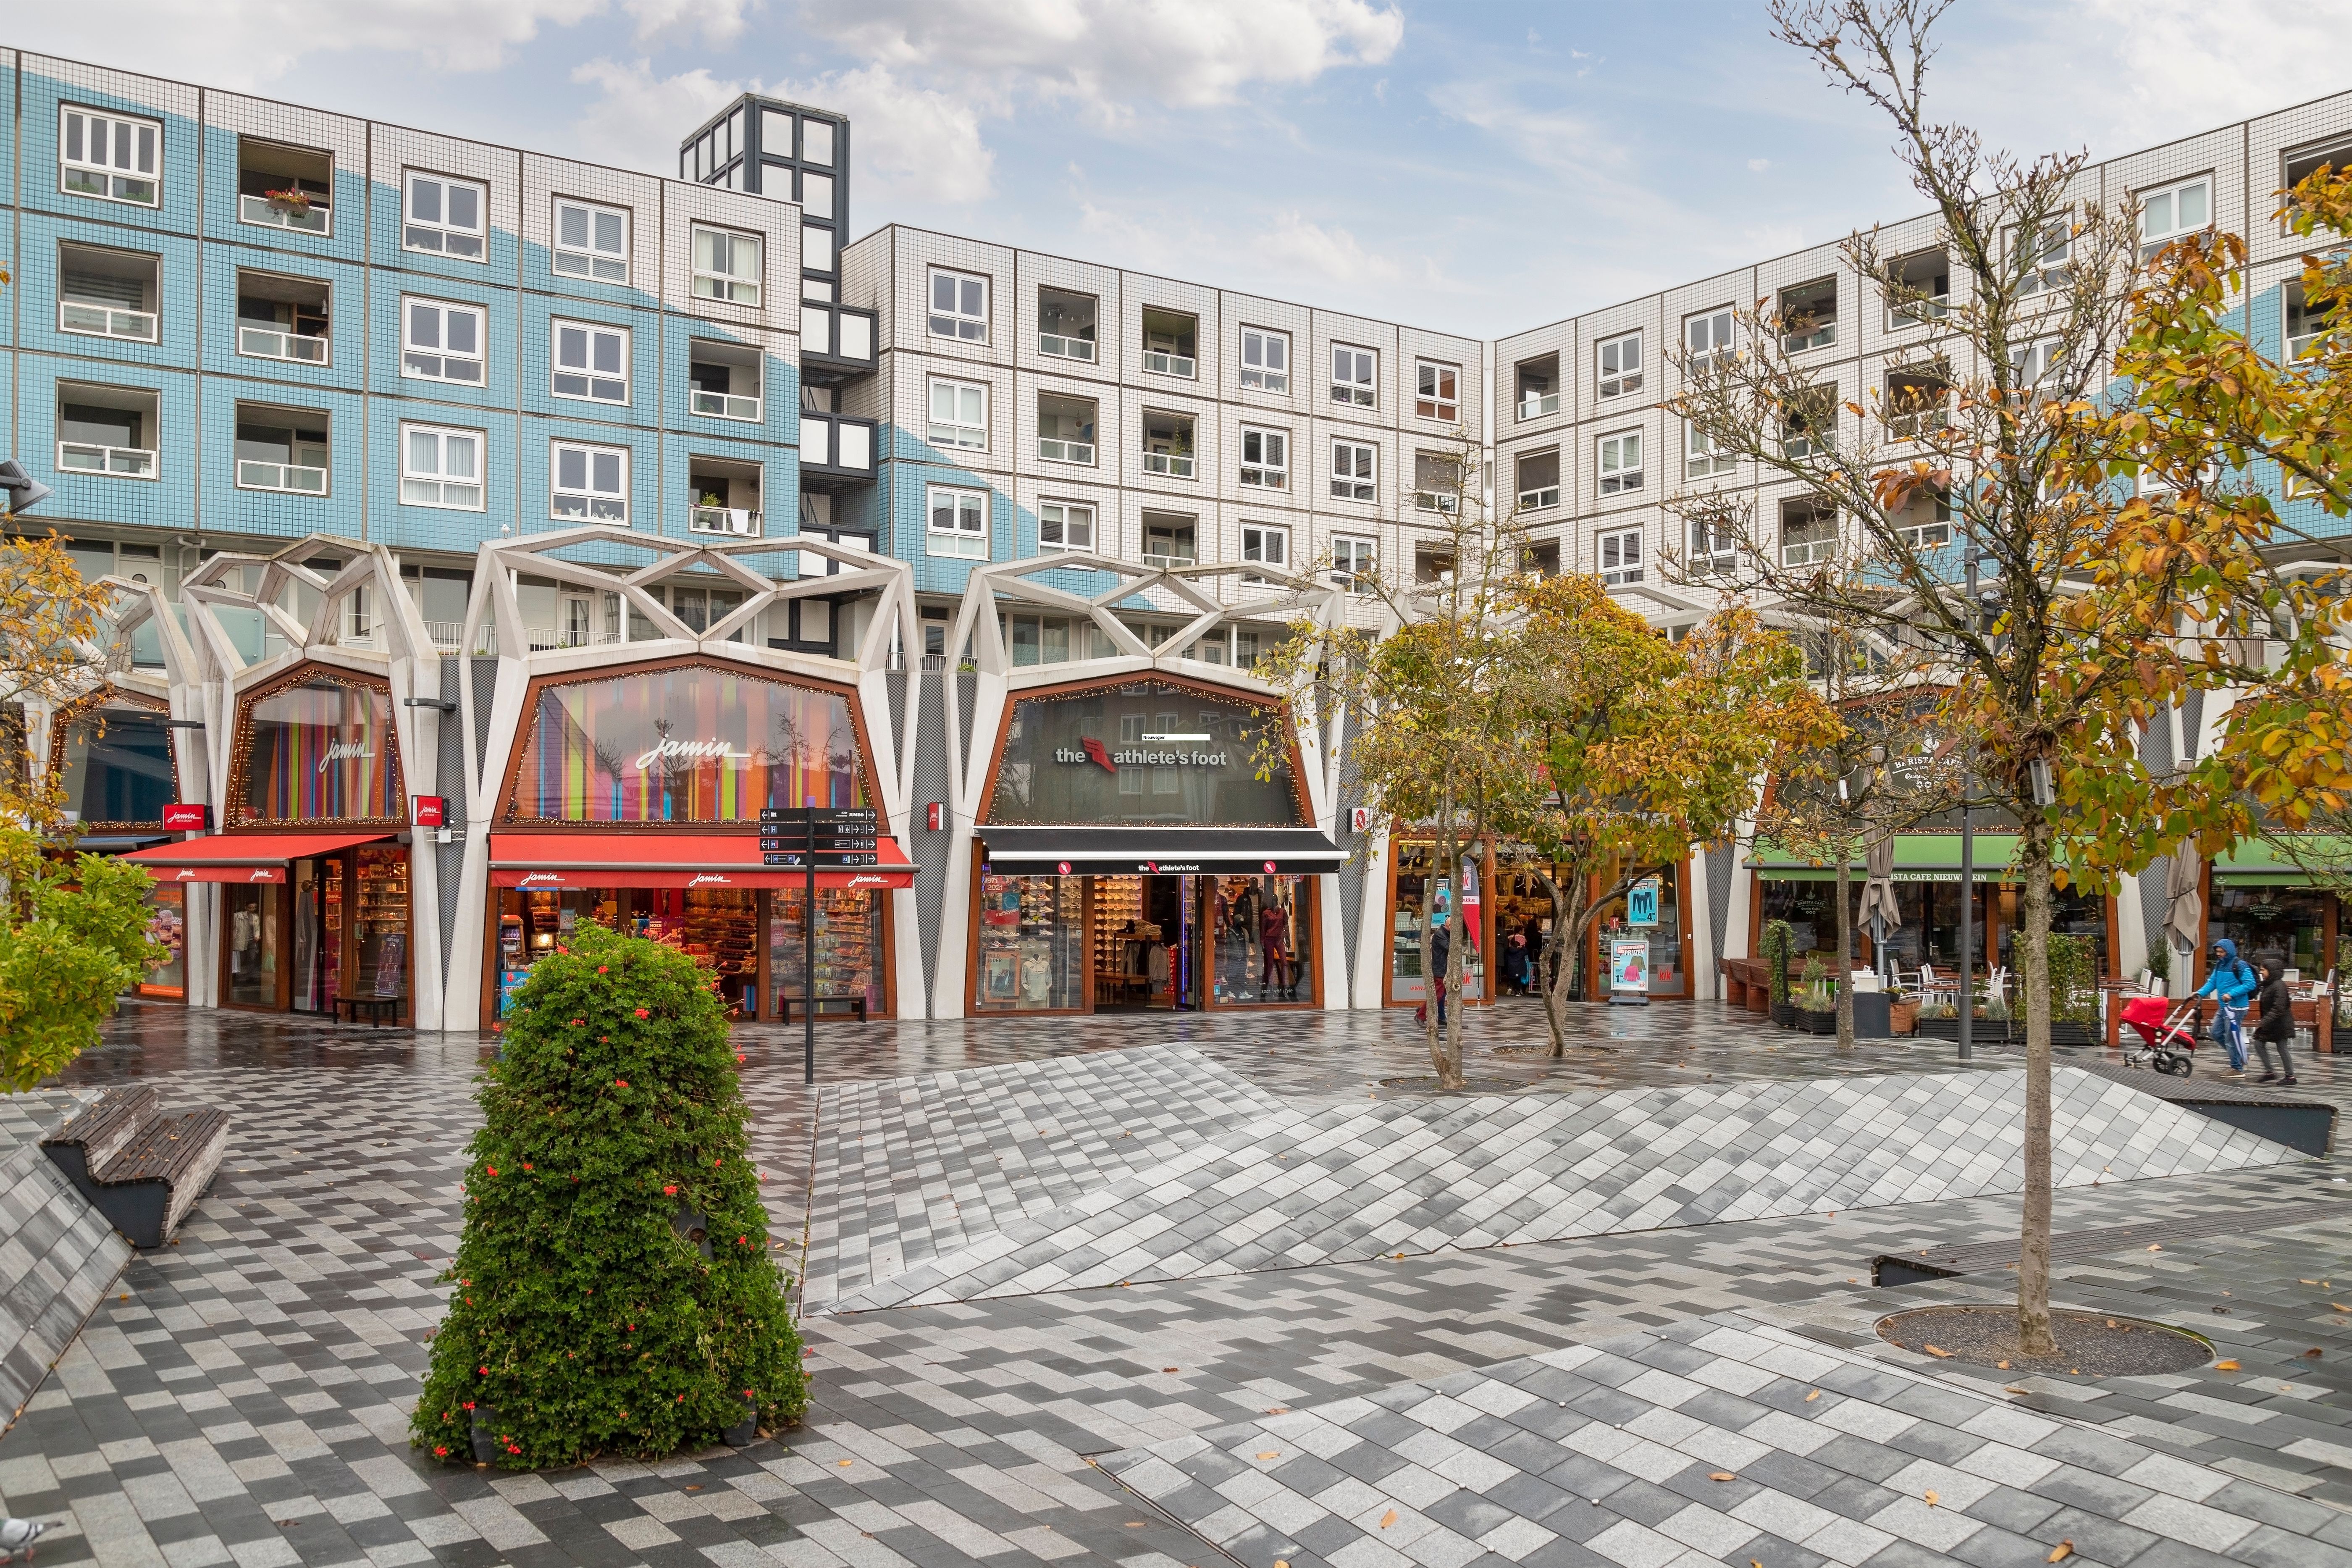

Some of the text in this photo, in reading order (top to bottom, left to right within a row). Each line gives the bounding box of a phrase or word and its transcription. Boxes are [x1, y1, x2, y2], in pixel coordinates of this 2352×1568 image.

[319, 738, 375, 773] jamin
[635, 733, 751, 769] jamin
[1055, 748, 1226, 765] the athlete's foot
[419, 804, 440, 817] jamin
[167, 812, 202, 823] jamin
[176, 868, 195, 880] jamin
[250, 868, 273, 882] jamin
[520, 872, 565, 885] jamin
[688, 873, 731, 887] jamin
[848, 874, 888, 887] jamin
[1462, 970, 1471, 984] ik
[1659, 967, 1671, 980] kik
